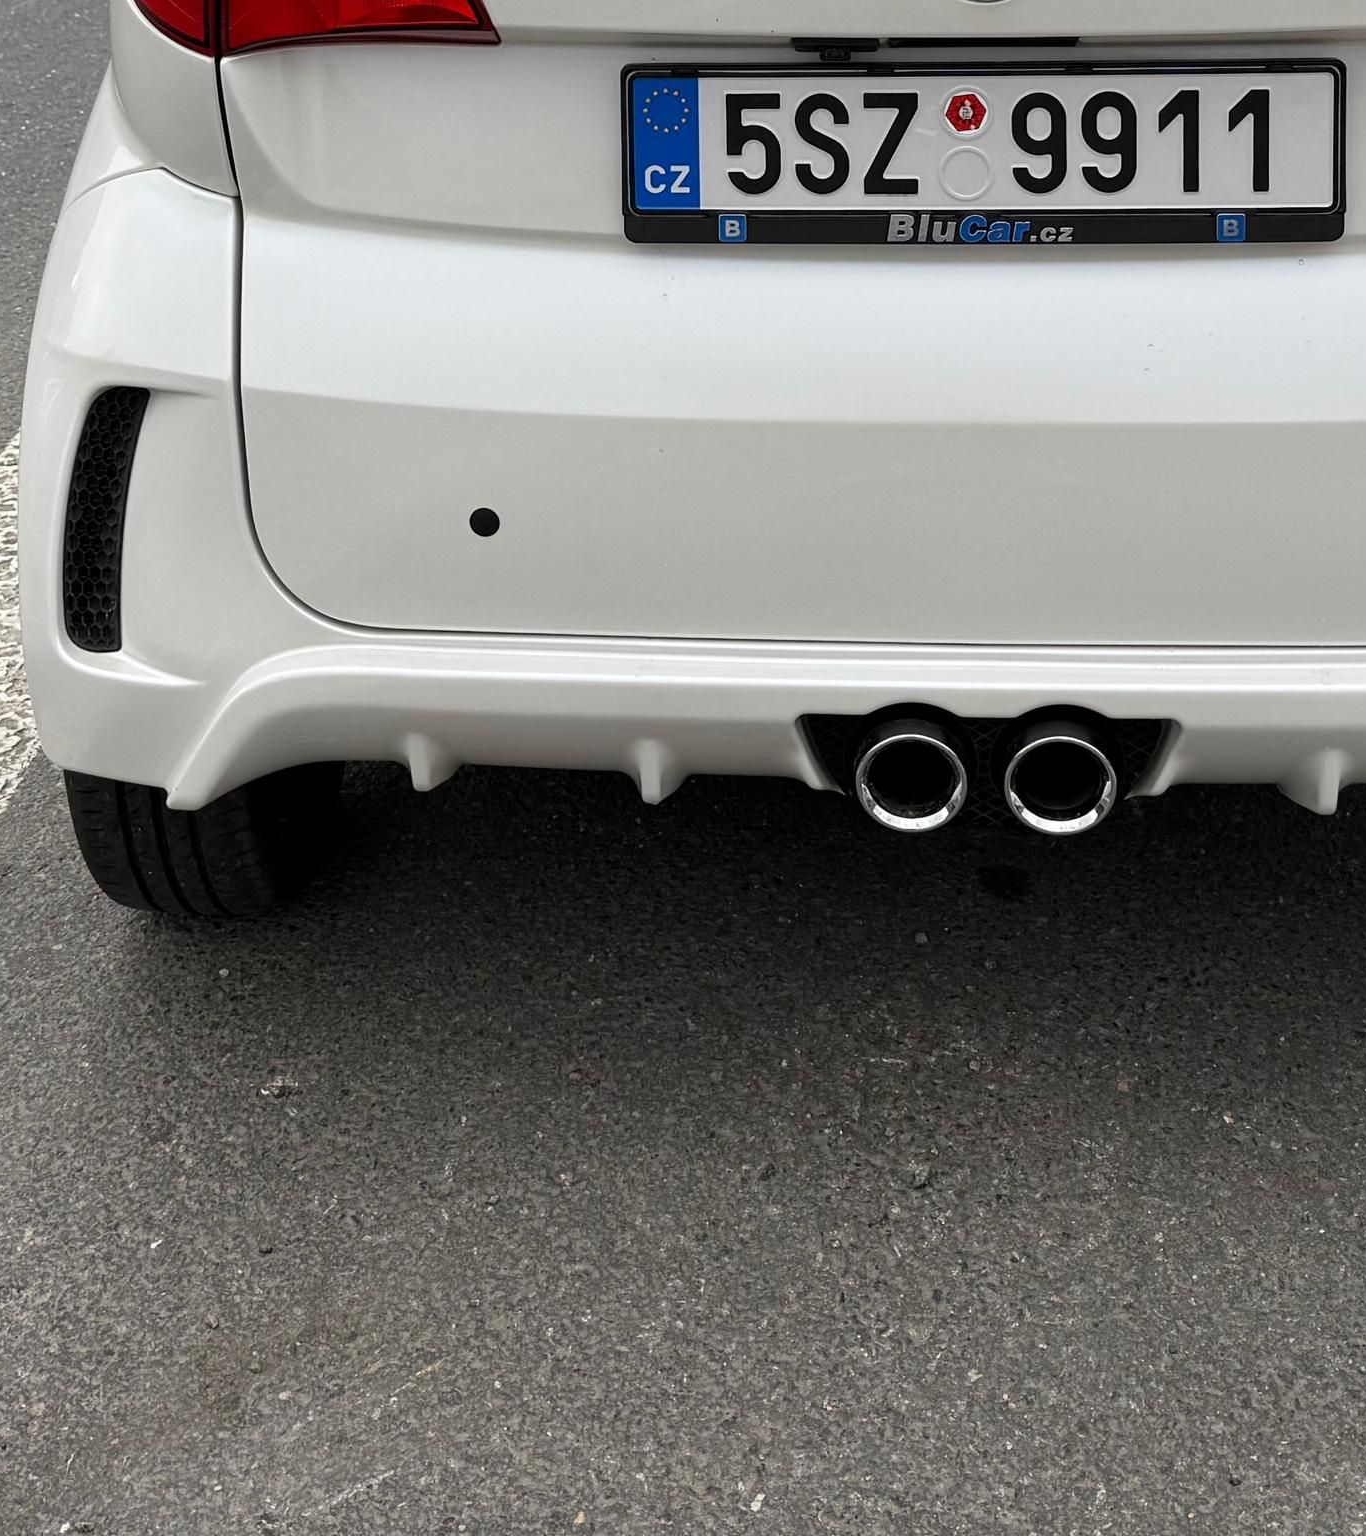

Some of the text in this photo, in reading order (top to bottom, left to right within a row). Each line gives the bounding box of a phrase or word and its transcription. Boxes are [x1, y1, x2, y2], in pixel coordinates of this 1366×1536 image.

[725, 88, 1270, 195] 5SZ 9911
[644, 165, 691, 194] CZ
[886, 214, 1074, 243] BluCar.cz
